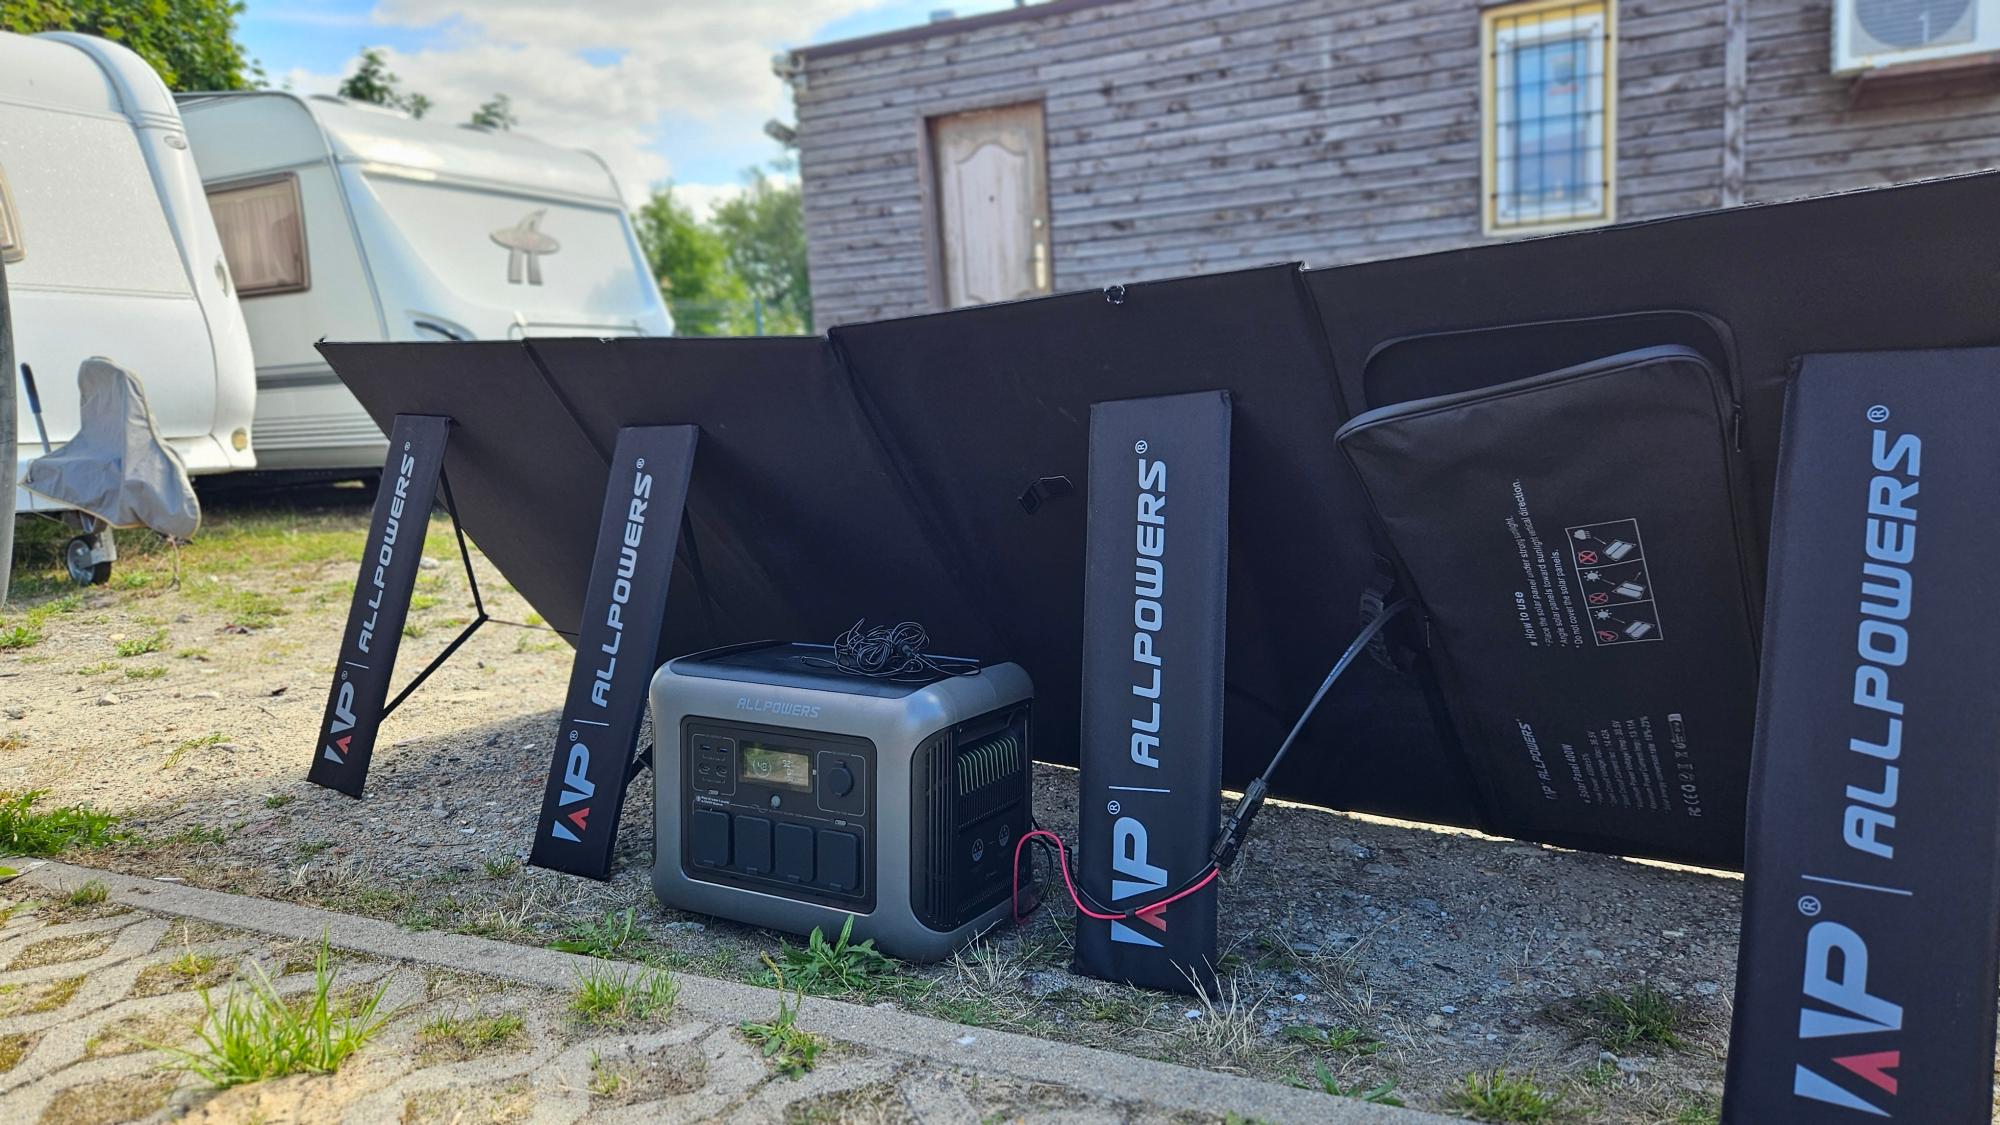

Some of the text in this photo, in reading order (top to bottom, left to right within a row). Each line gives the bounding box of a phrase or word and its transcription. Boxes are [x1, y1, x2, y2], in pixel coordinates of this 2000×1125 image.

[1516, 539, 1528, 557] strong
[1522, 559, 1534, 577] under
[1537, 564, 1551, 587] toward
[1528, 578, 1541, 598] panel
[1558, 577, 1569, 594] solar
[1533, 600, 1545, 615] solar
[1545, 588, 1559, 610] panels
[1563, 595, 1572, 604] the
[1515, 591, 1537, 639] How to use
[1539, 617, 1548, 626] the
[1552, 610, 1563, 626] solar
[1566, 606, 1577, 624] cover
[1570, 624, 1580, 634] not
[1574, 634, 1583, 644] Do
[736, 698, 821, 718] ALLPOWERS
[1562, 743, 1576, 761] 400W
[1568, 763, 1583, 781] Panel
